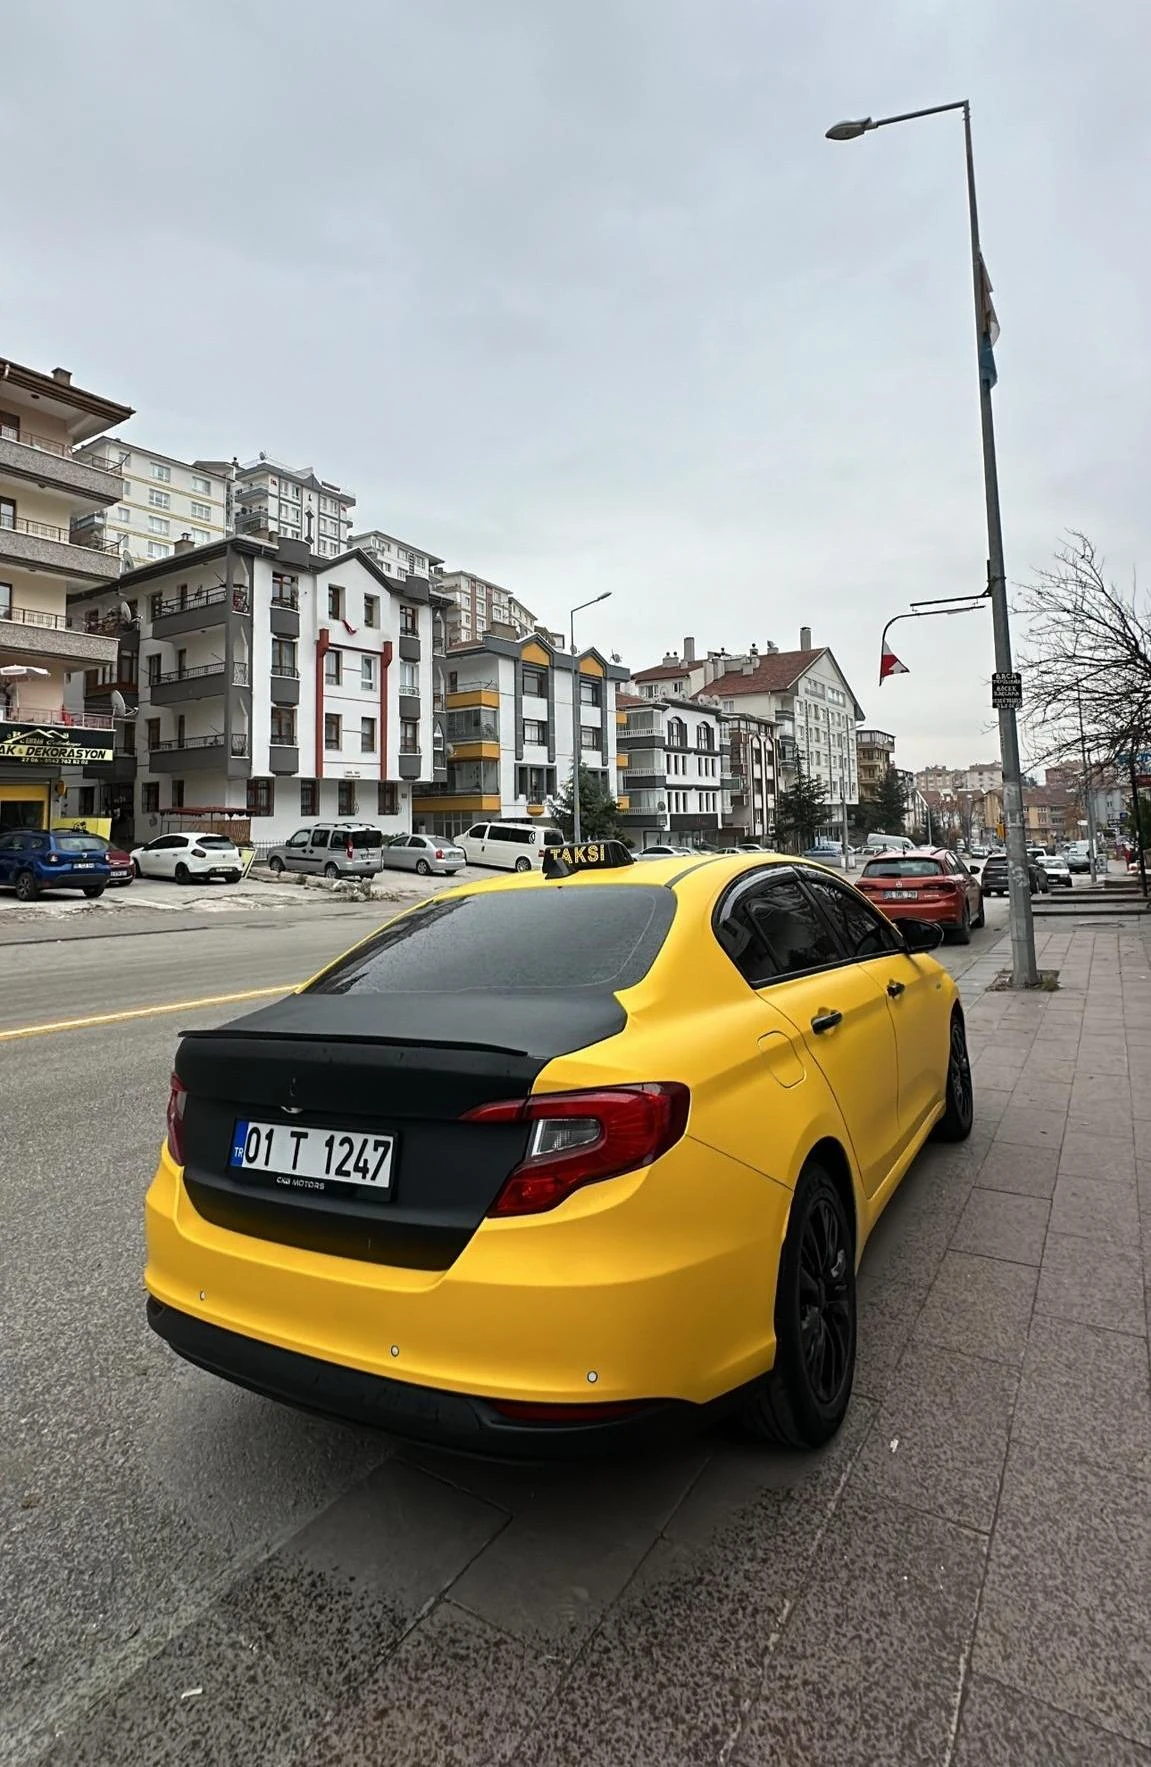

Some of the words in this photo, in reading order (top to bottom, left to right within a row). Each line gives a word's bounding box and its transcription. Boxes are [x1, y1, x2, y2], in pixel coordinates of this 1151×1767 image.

[26, 746, 106, 758] DEKORASYON
[234, 1146, 244, 1158] TR
[245, 1126, 275, 1167] 01
[290, 1130, 308, 1171] T
[324, 1134, 391, 1181] 1247
[292, 1179, 325, 1190] MOTORS
